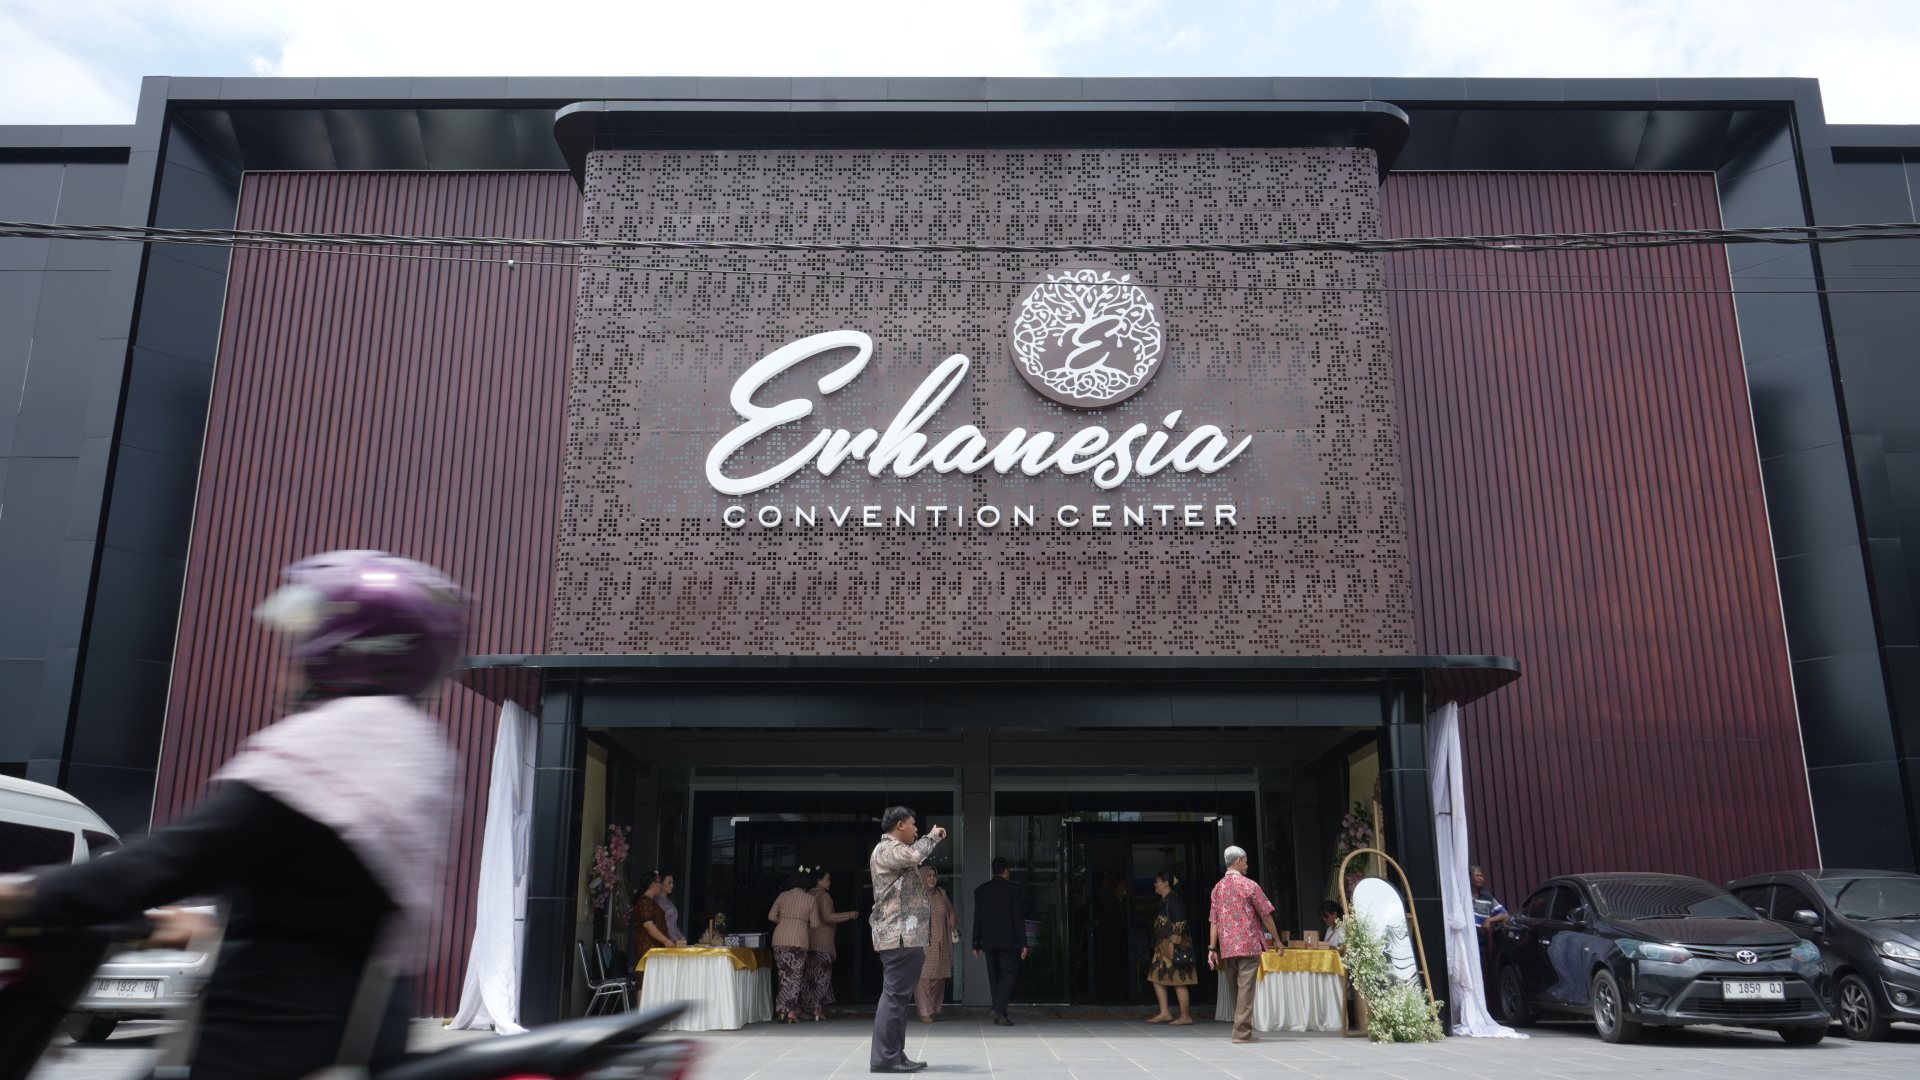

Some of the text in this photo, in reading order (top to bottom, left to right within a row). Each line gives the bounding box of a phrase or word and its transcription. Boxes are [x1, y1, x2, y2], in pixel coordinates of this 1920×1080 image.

[1064, 314, 1124, 377] E
[705, 329, 1252, 496] Erhanesia
[722, 504, 1239, 529] CONVENTION CENTER
[116, 981, 138, 992] 1932
[1725, 983, 1732, 993] R
[1738, 983, 1761, 993] 1859
